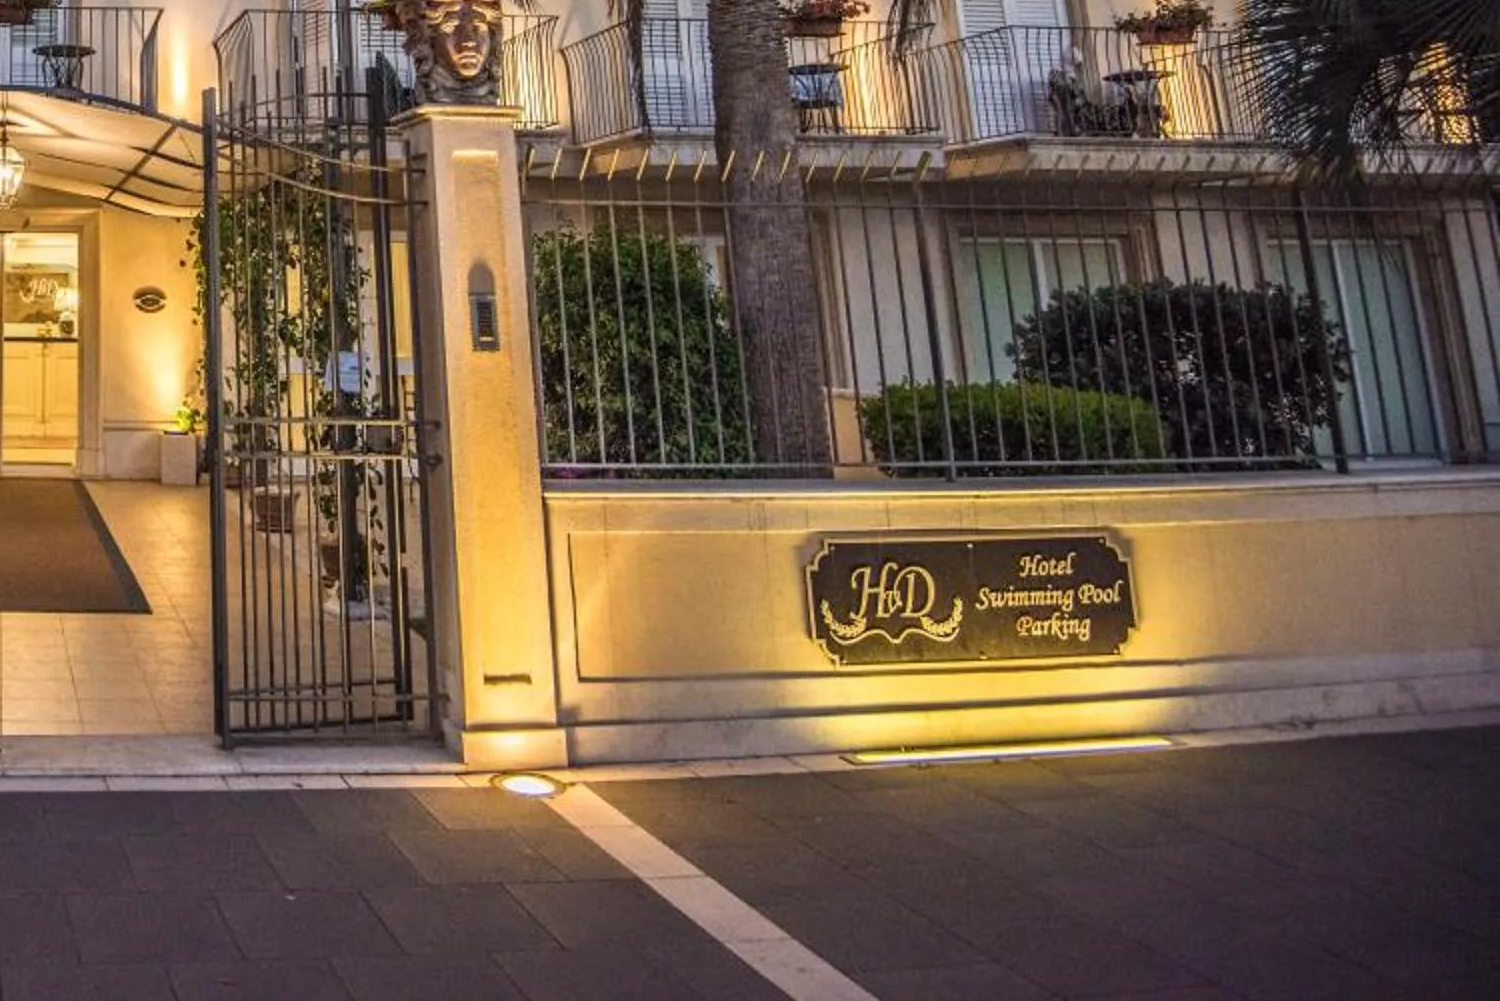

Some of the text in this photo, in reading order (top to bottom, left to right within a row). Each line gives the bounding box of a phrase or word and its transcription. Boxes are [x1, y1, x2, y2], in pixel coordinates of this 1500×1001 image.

[1019, 552, 1076, 577] Hotel
[975, 580, 1125, 611] Swimming Pool
[1017, 615, 1091, 641] Parking
